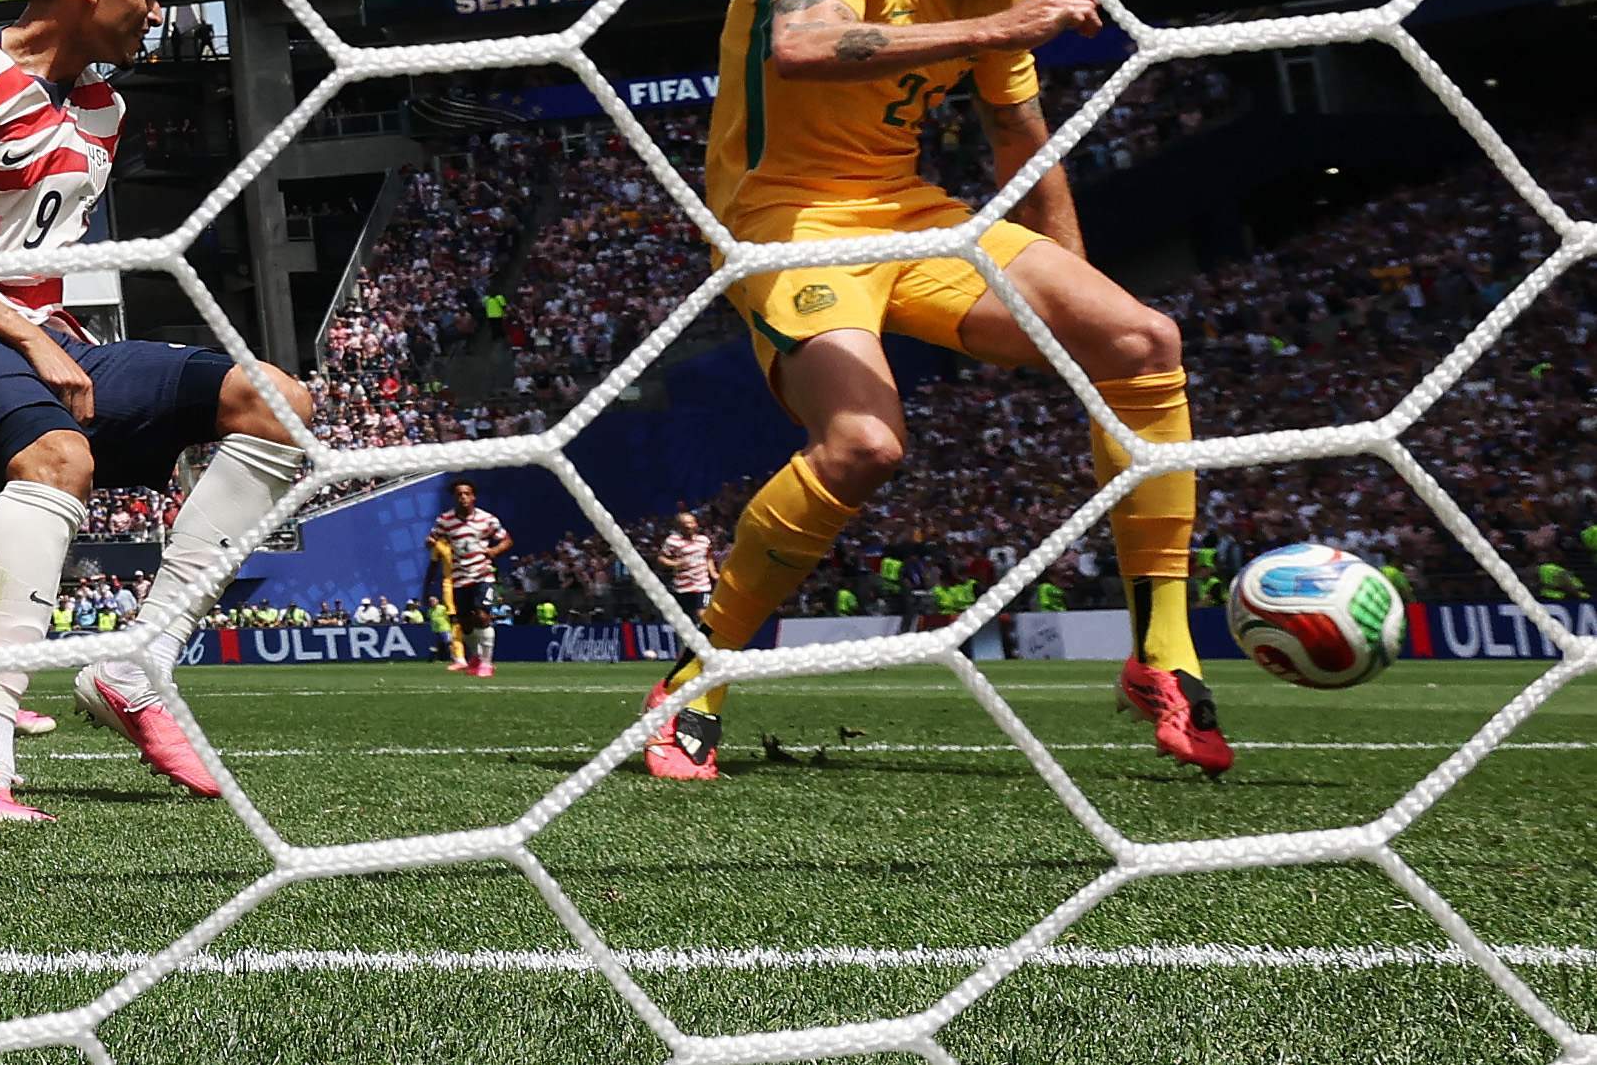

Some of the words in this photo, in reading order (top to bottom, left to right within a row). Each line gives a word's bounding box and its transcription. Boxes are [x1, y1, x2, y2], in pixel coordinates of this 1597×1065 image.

[629, 78, 701, 105] FIFA
[88, 145, 107, 167] USA
[23, 190, 63, 250] 9
[254, 625, 417, 663] ULTRA
